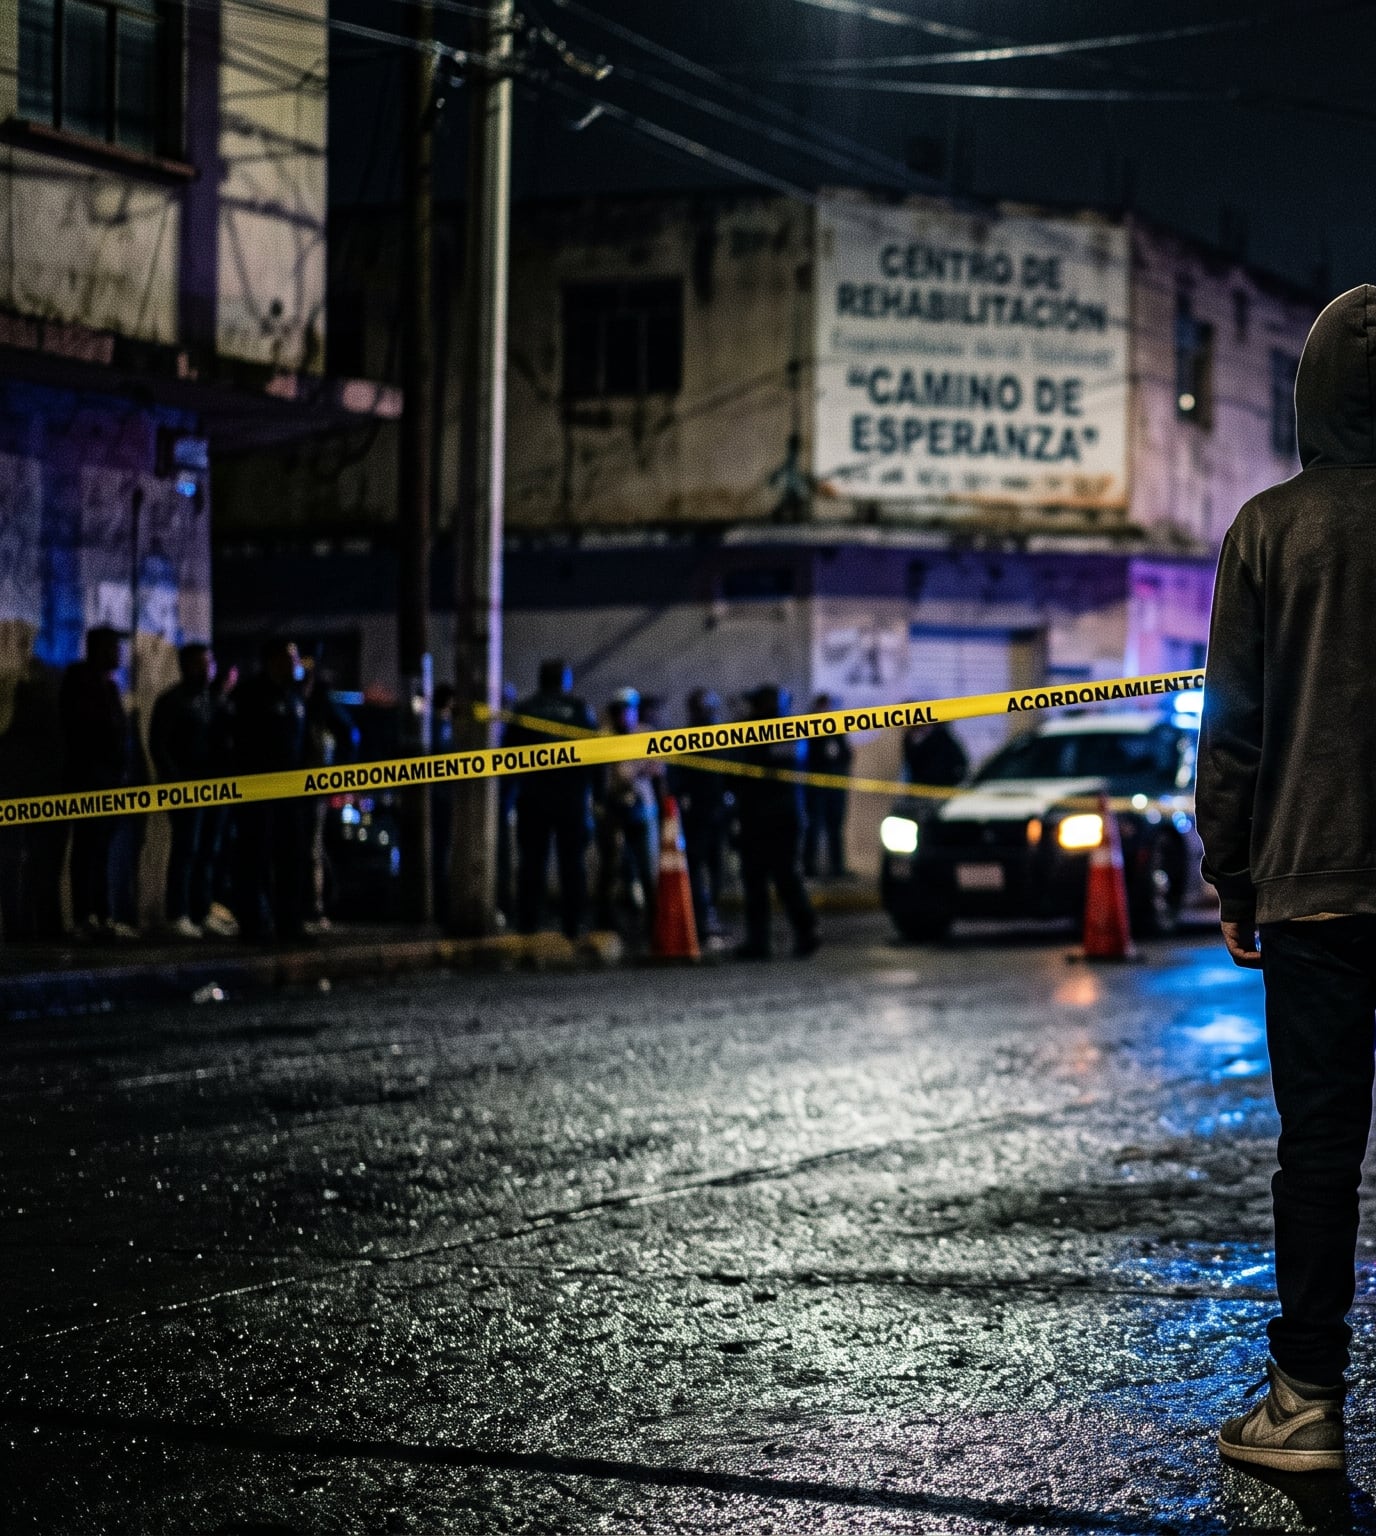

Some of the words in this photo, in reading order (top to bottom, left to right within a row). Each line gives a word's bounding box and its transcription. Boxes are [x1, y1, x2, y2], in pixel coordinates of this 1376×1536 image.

[880, 244, 1013, 284] CENTRO
[1021, 253, 1062, 290] DE
[1034, 375, 1084, 417] DE
[1007, 675, 1204, 712] ACORDONAMIENTO
[646, 718, 837, 754] ACORDONAMIENTO
[844, 707, 938, 731] POLICIAL
[304, 756, 485, 791] ACORDONAMIENTO
[492, 746, 581, 771] POLICIAL
[0, 791, 151, 823] ORDONAMIENTO
[157, 782, 243, 807] POLICIAL
